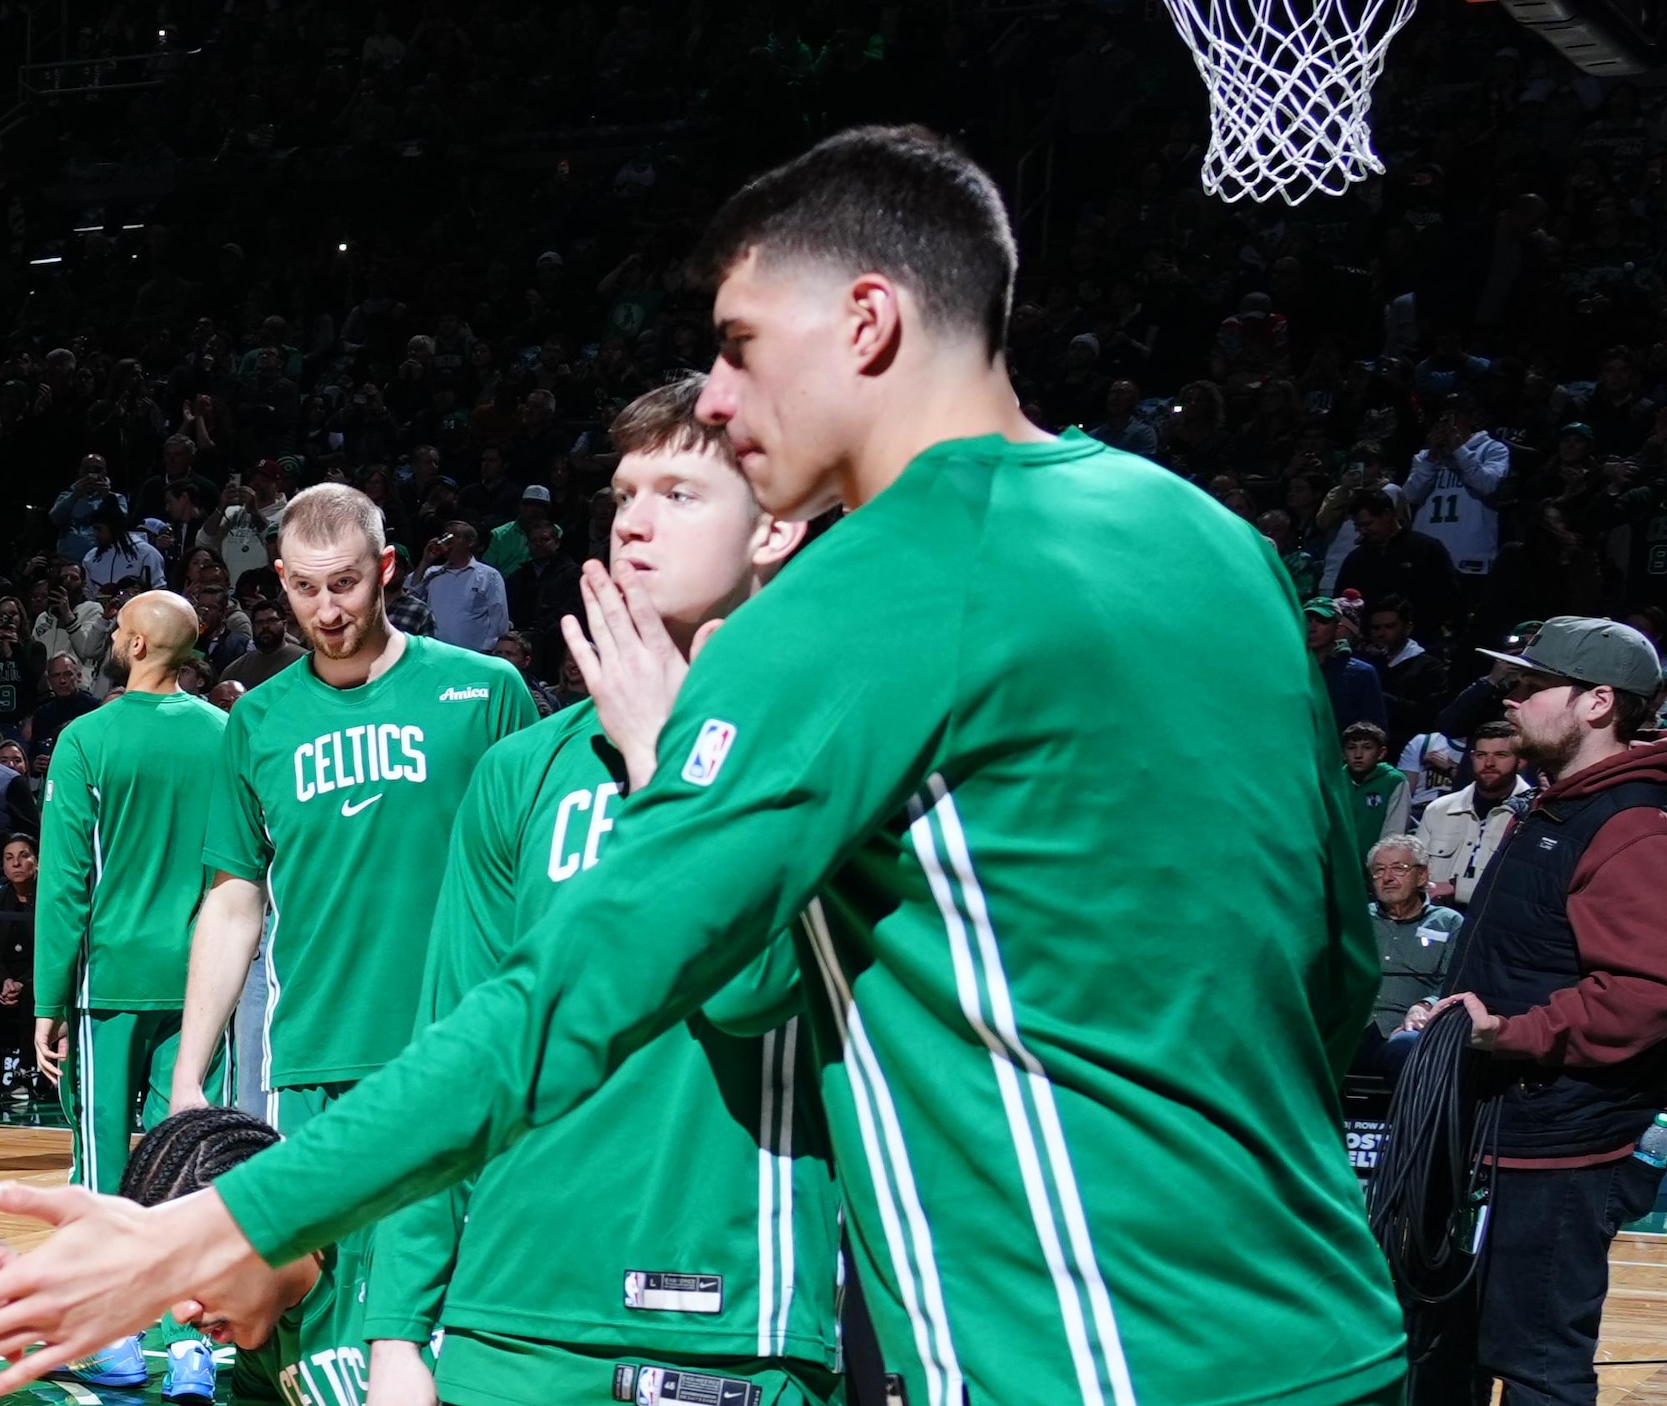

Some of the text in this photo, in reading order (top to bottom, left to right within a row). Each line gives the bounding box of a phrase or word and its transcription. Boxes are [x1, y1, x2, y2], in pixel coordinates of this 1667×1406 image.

[1429, 494, 1458, 524] 11
[439, 687, 489, 701] Amica
[294, 723, 427, 802] CELTICS
[1354, 1120, 1378, 1131] ROW
